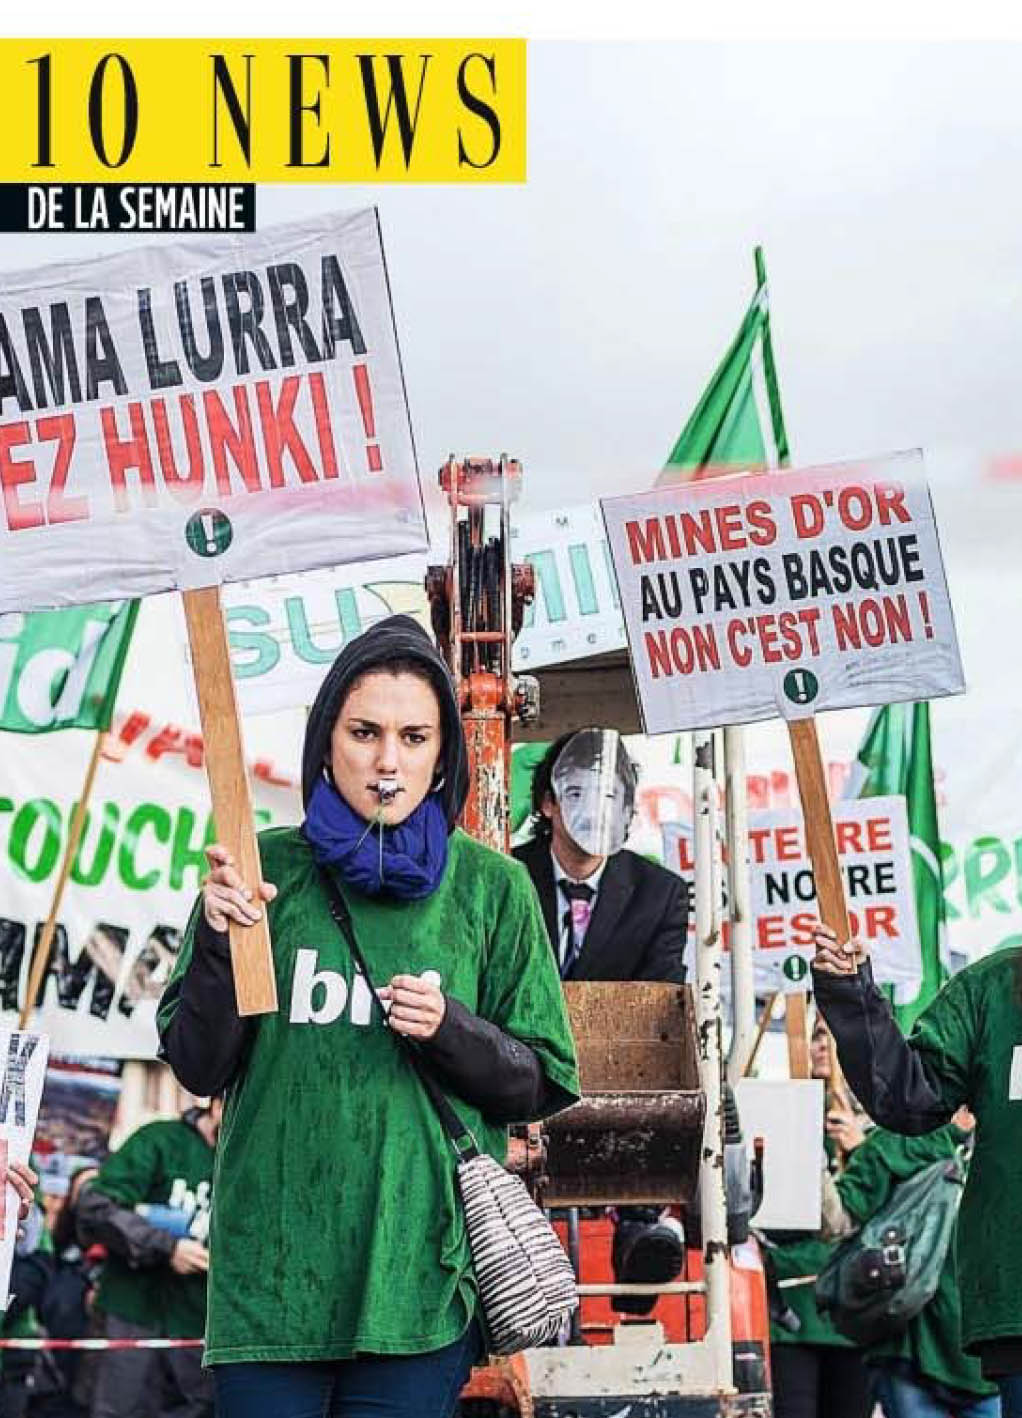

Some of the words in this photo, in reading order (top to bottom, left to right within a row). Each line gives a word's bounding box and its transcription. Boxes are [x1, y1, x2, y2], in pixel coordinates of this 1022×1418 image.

[26, 51, 139, 170] 10
[208, 52, 502, 172] NEWS
[28, 189, 64, 229] DE
[75, 189, 110, 229] LA
[120, 188, 245, 230] SEMAINE
[0, 296, 128, 415] AMA
[137, 255, 367, 388] LURRA
[0, 411, 89, 531] EZ
[101, 373, 340, 508] HUNKI
[625, 501, 777, 565] MINES
[791, 484, 912, 540] D'OR
[640, 572, 681, 622] AU
[692, 558, 776, 614] PAYS
[782, 534, 924, 600] BASQUE
[644, 616, 720, 679] NON
[728, 608, 822, 667] C'EST
[833, 594, 913, 652] NON
[748, 818, 892, 863] TERE
[764, 861, 896, 905] NORE
